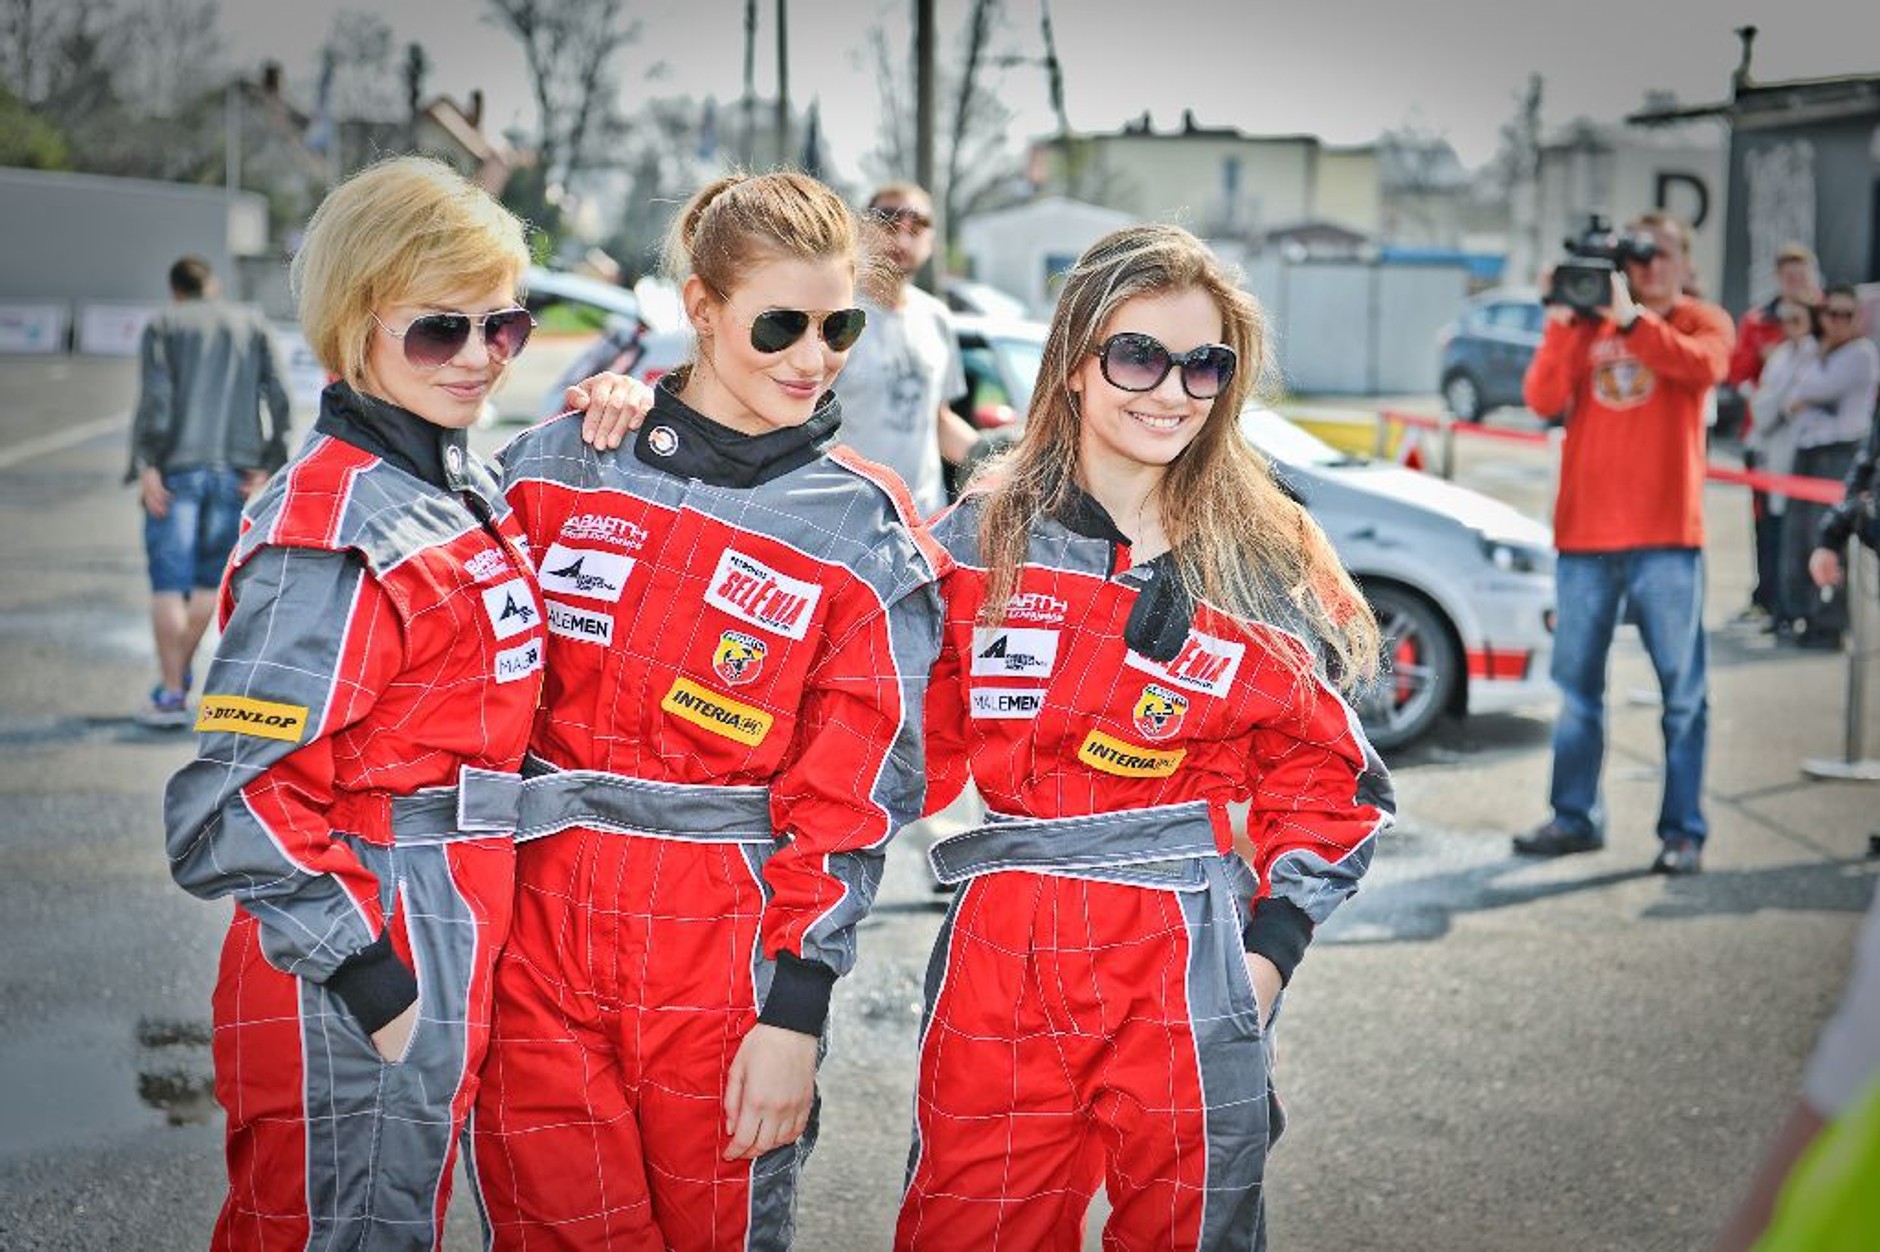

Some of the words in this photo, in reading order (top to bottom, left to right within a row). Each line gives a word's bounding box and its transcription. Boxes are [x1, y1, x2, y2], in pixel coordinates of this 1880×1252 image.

[563, 514, 648, 541] ABARTH
[547, 609, 609, 638] ALEMEN
[213, 707, 297, 728] DUNLOP
